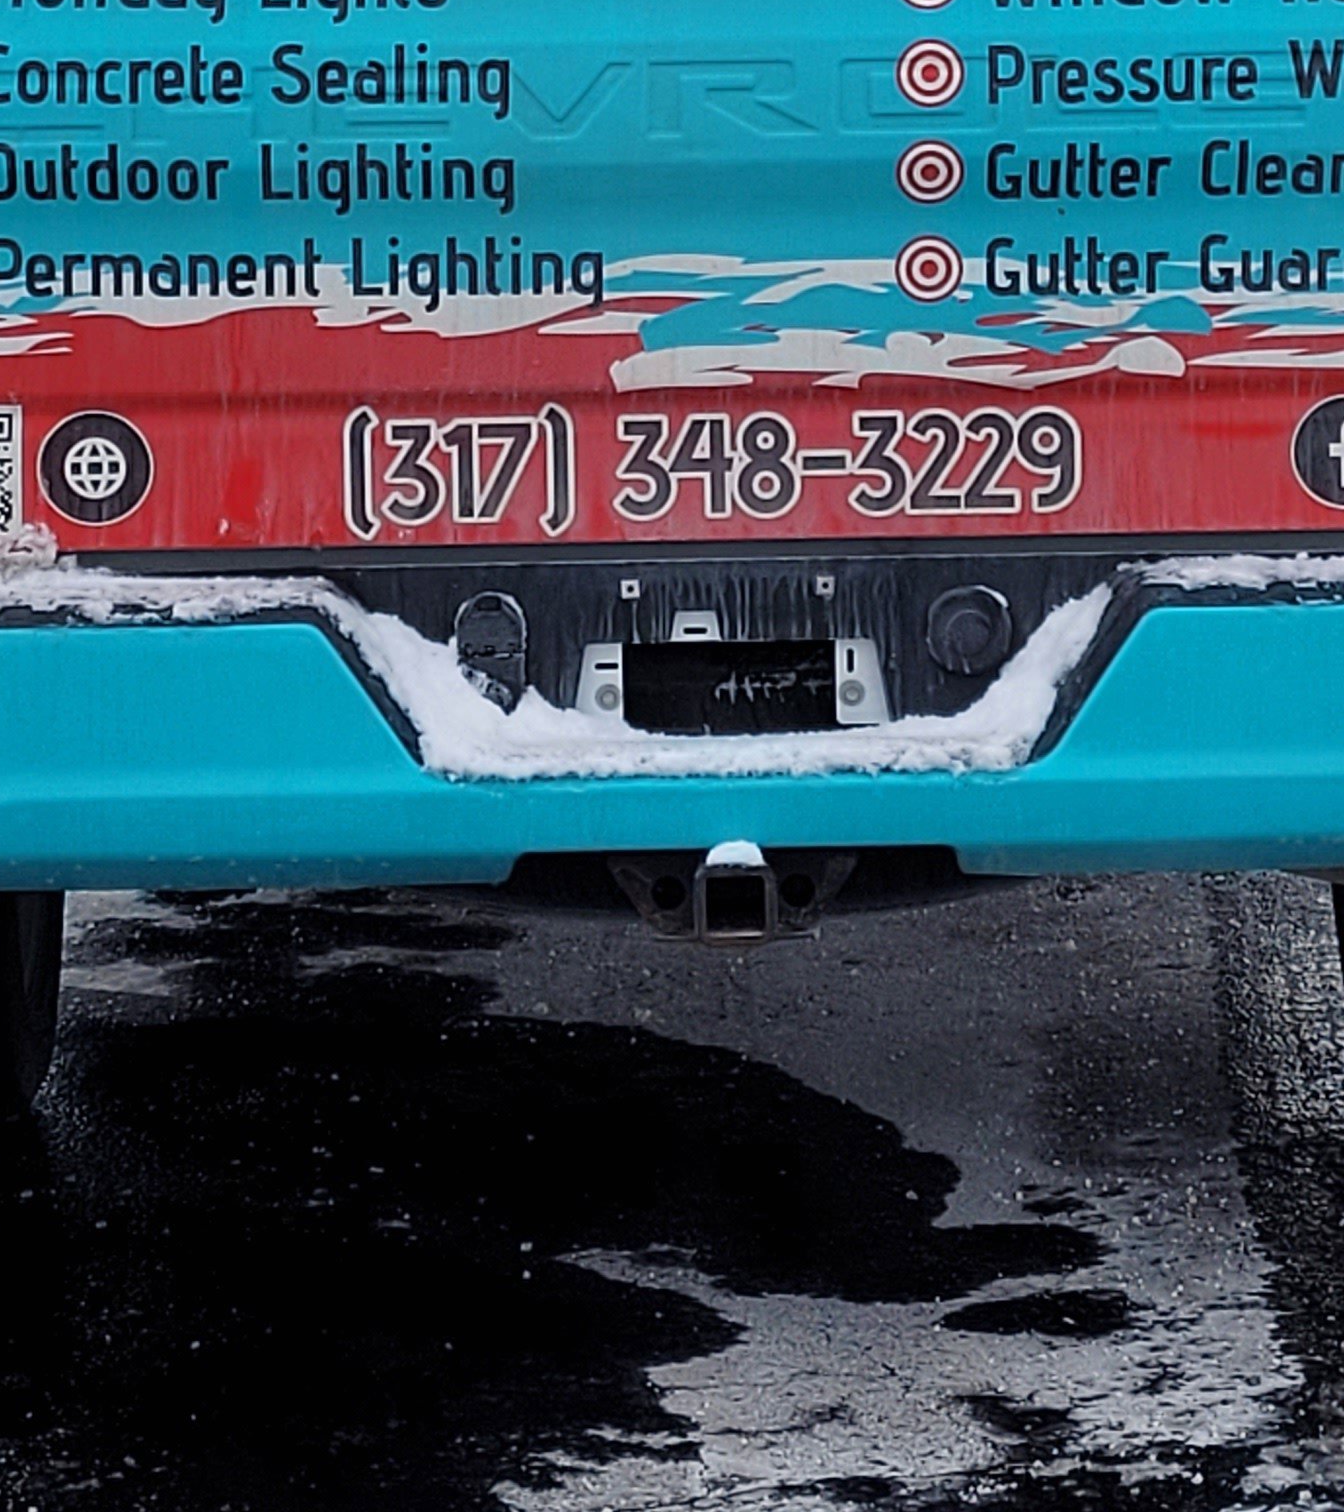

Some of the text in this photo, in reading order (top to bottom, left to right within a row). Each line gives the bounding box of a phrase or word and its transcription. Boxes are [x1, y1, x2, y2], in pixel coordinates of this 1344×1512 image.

[270, 44, 511, 120] Sealing
[986, 43, 1258, 106] Pressure
[260, 143, 515, 215] Lighting
[986, 141, 1172, 202] Gutter
[351, 237, 605, 312] Lighting
[986, 235, 1169, 297] Gutter
[344, 402, 1083, 539] (317) 348-3229
